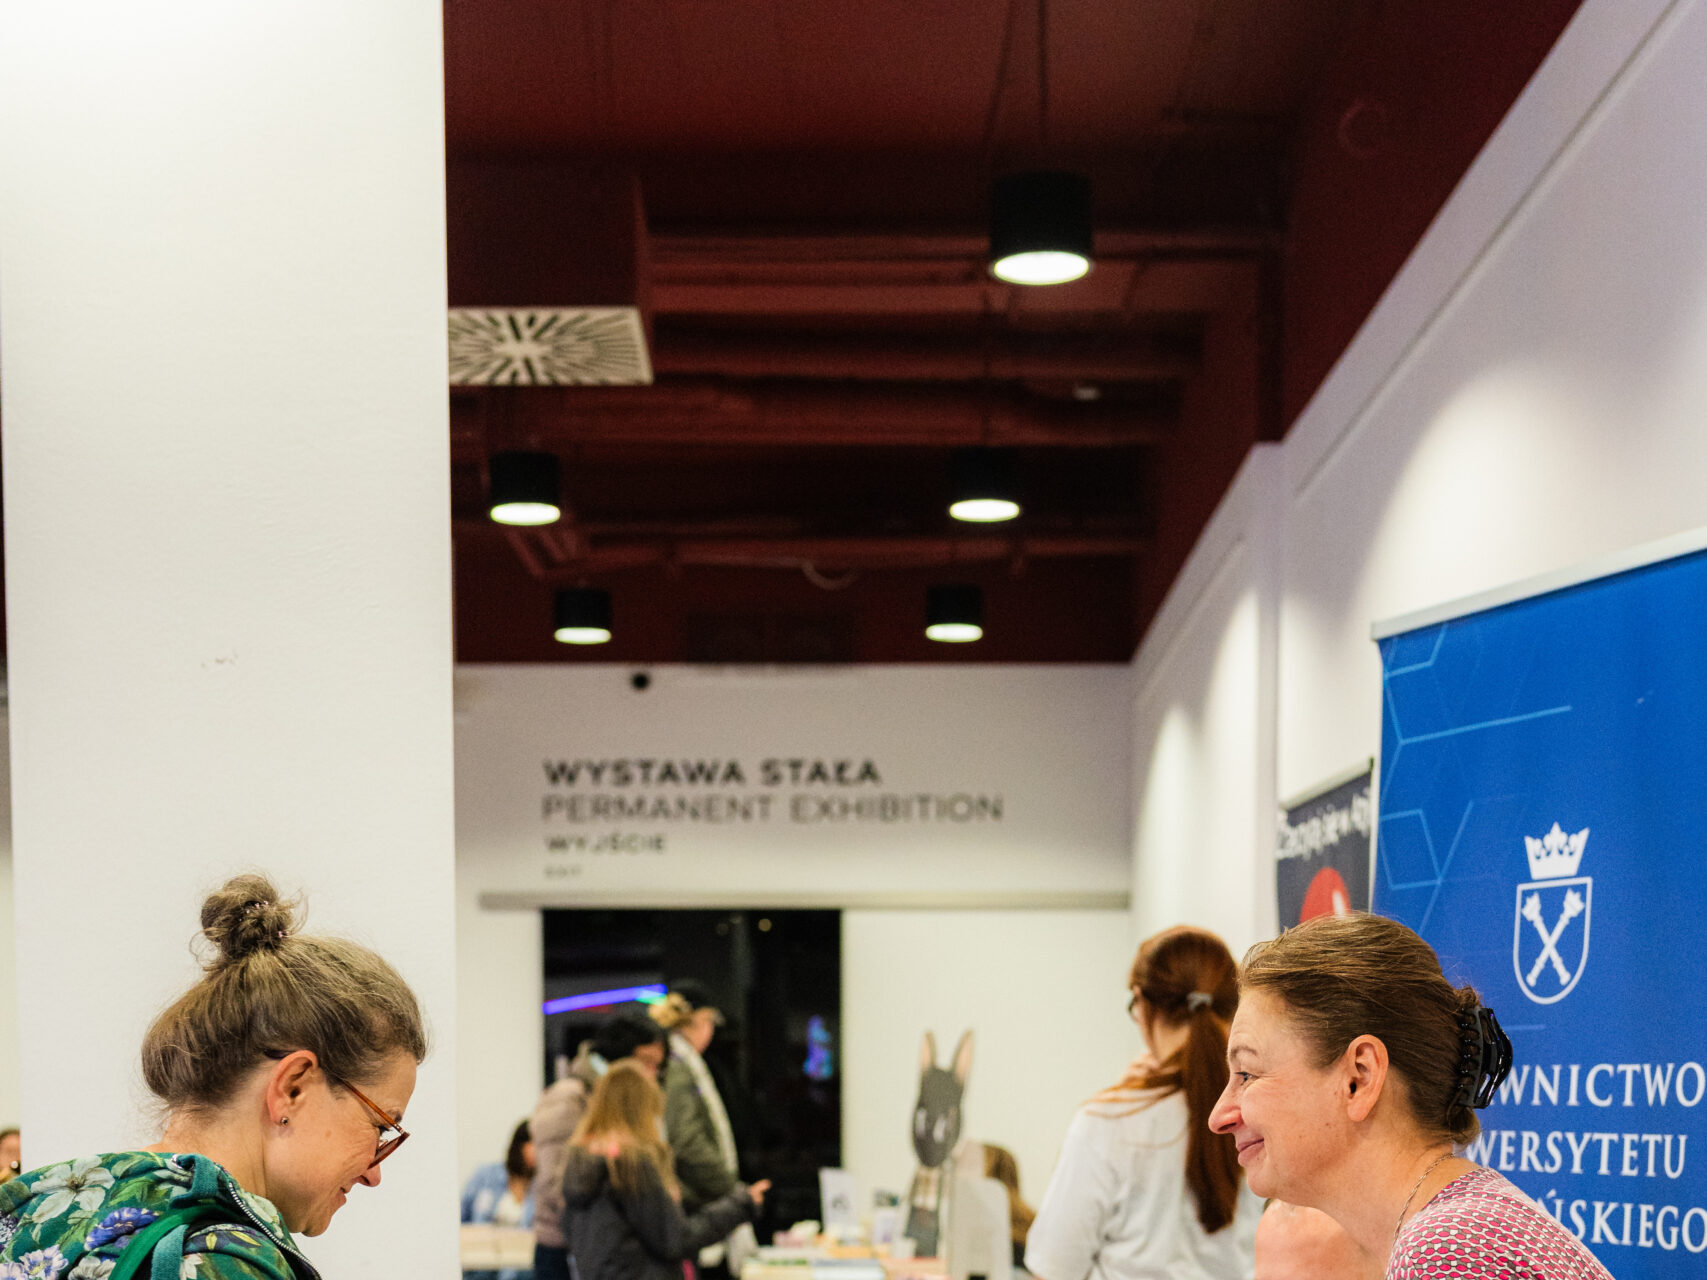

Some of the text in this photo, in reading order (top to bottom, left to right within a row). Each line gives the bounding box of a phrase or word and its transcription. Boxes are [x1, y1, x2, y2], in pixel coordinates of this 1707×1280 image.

[543, 759, 882, 786] WYSTAWA STAŁA
[541, 793, 1004, 824] PERMANENT EXHIBITION
[1496, 1061, 1706, 1108] WNICTWO
